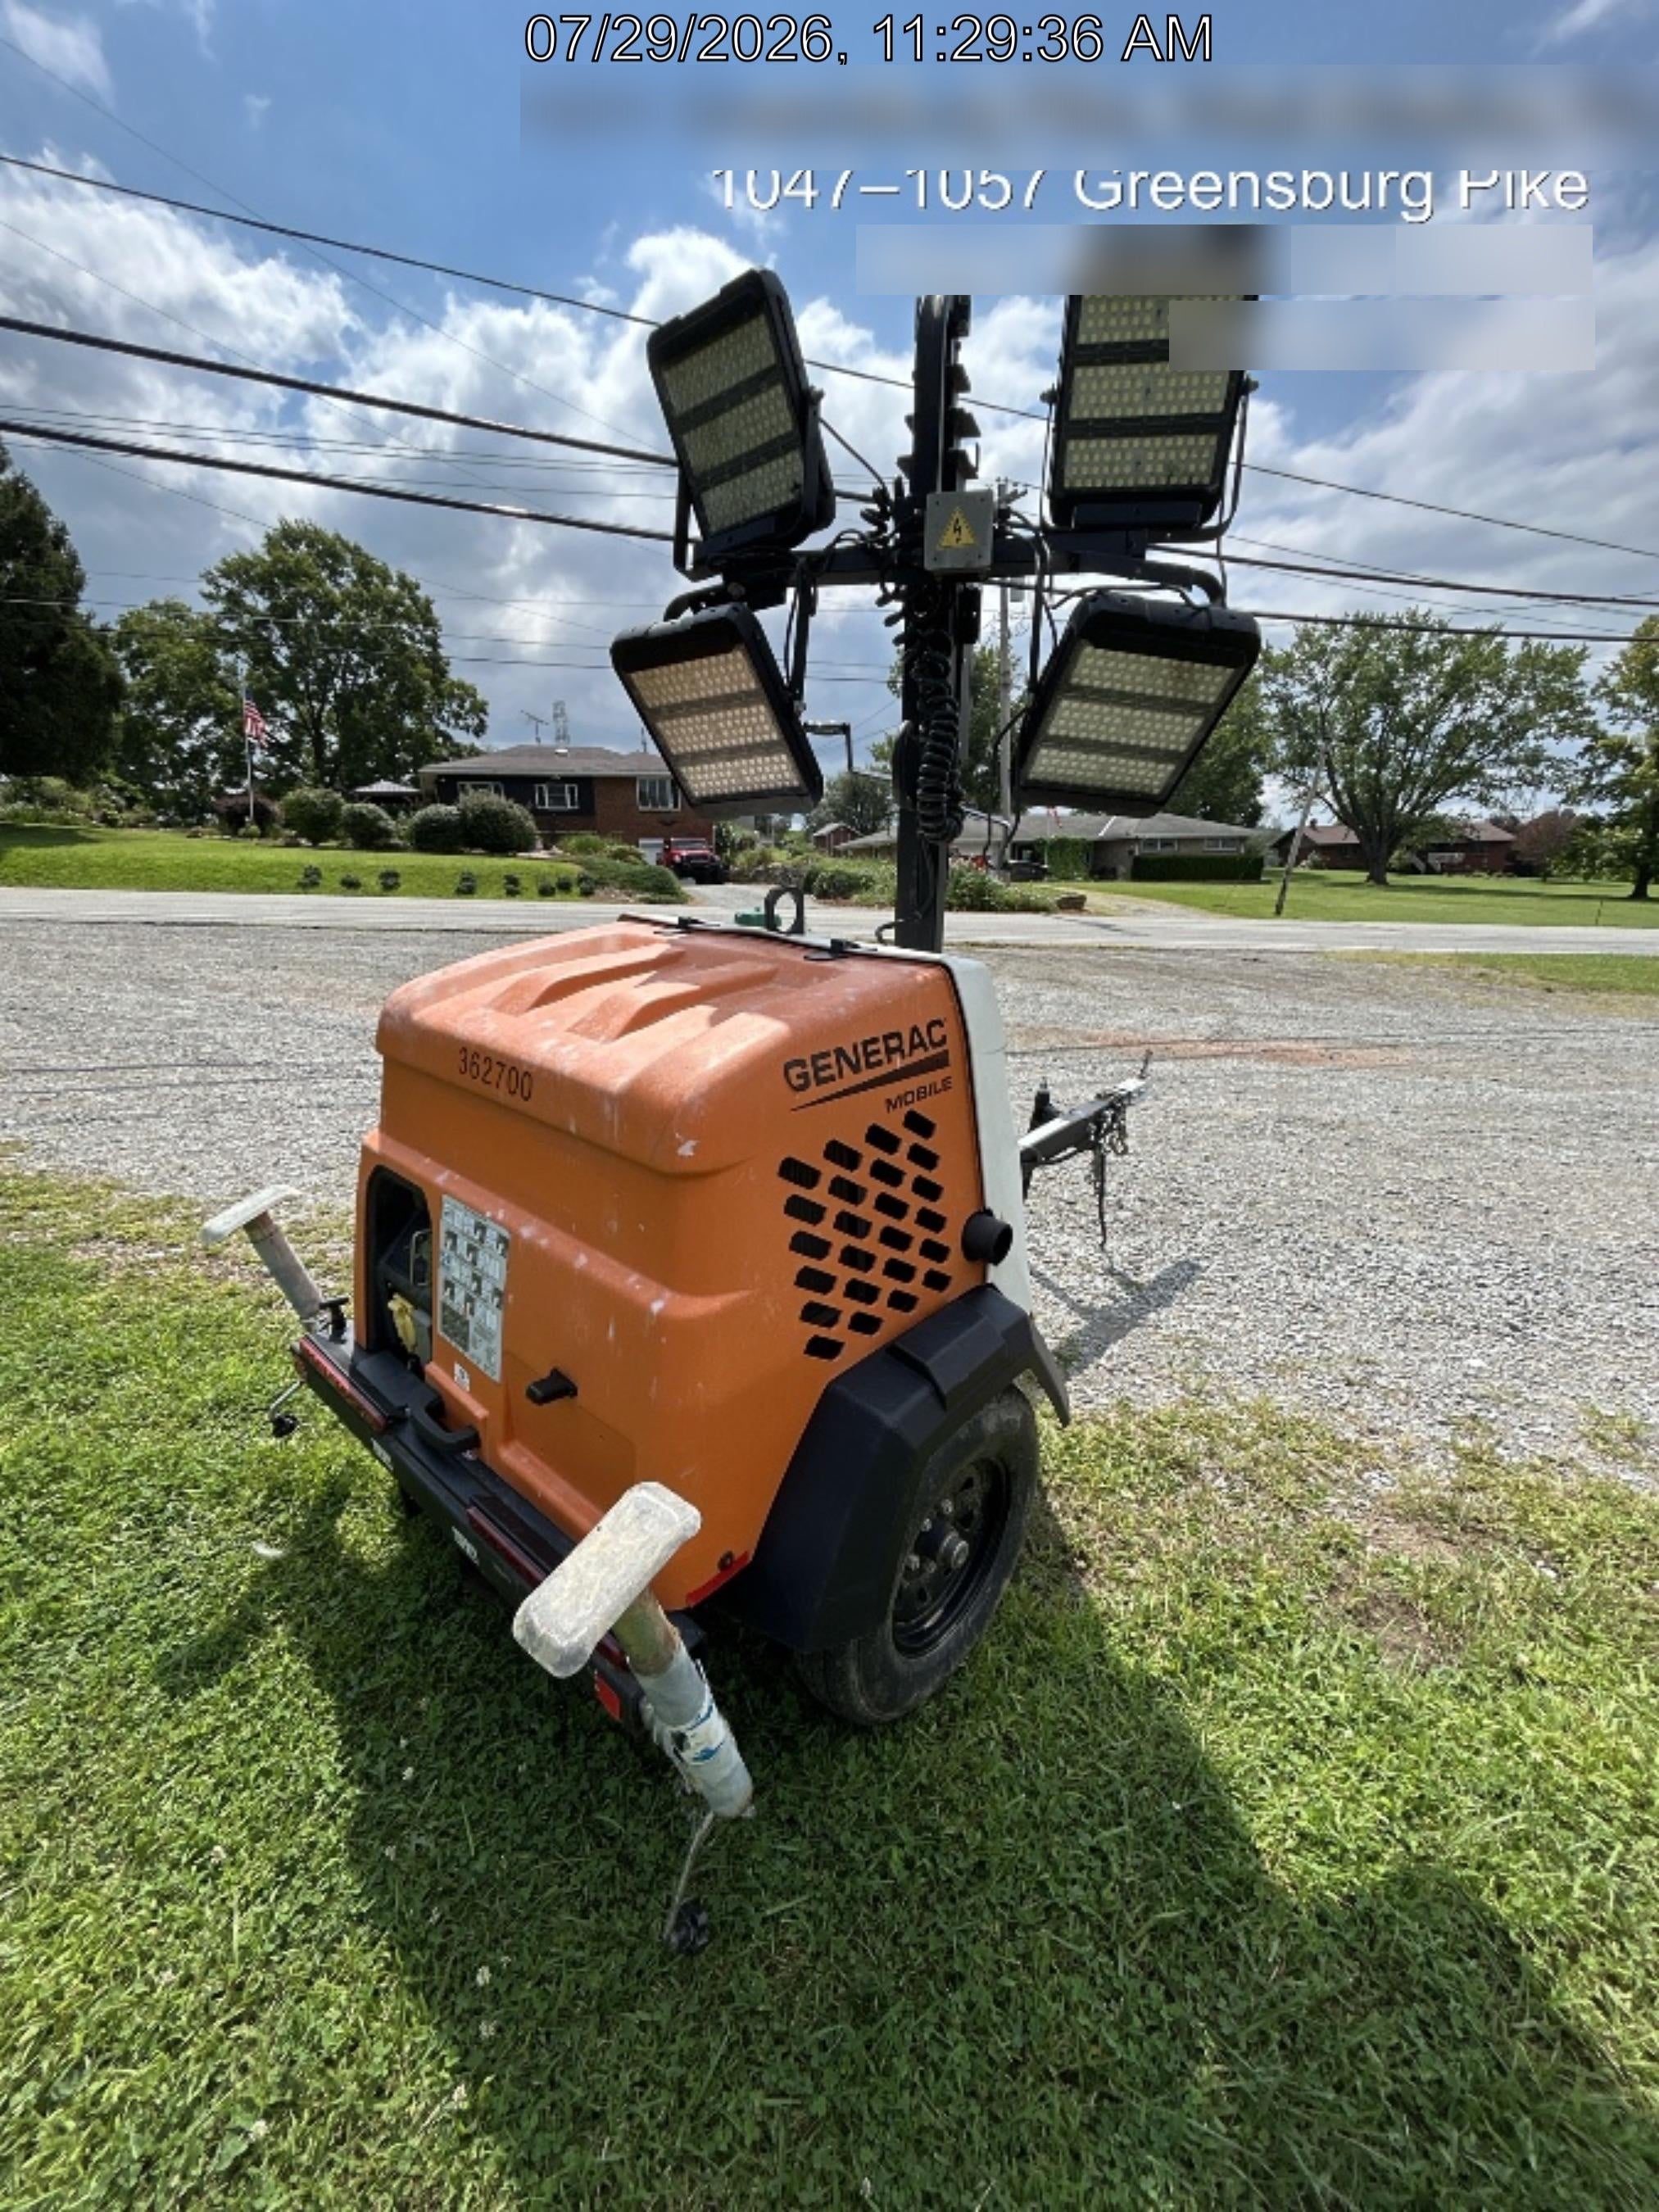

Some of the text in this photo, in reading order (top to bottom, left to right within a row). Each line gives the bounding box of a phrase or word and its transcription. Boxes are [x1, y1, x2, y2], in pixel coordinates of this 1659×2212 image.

[459, 1046, 533, 1102] 362700
[783, 1019, 948, 1092] GENERAC
[885, 1076, 954, 1114] MOBILE
